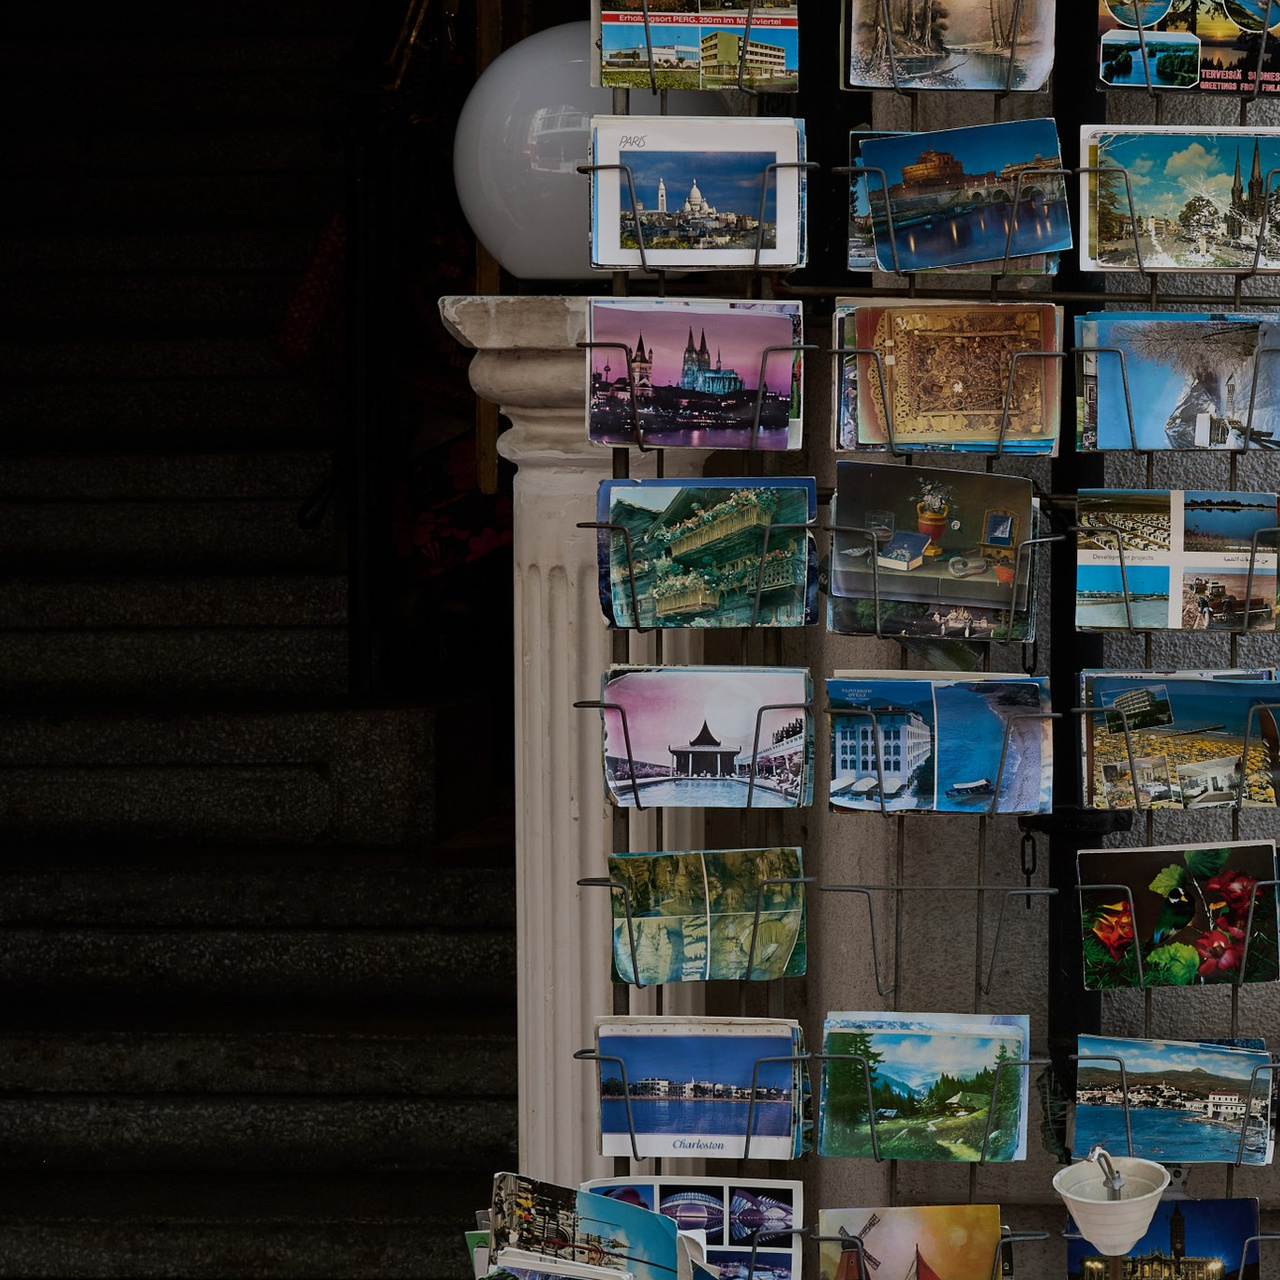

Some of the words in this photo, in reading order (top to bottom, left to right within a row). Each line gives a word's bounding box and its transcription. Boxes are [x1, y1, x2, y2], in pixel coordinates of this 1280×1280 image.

[1240, 82, 1257, 92] FRO
[619, 135, 648, 148] PARIS
[1092, 553, 1130, 563] Developnt
[672, 1138, 724, 1150] Charleston
